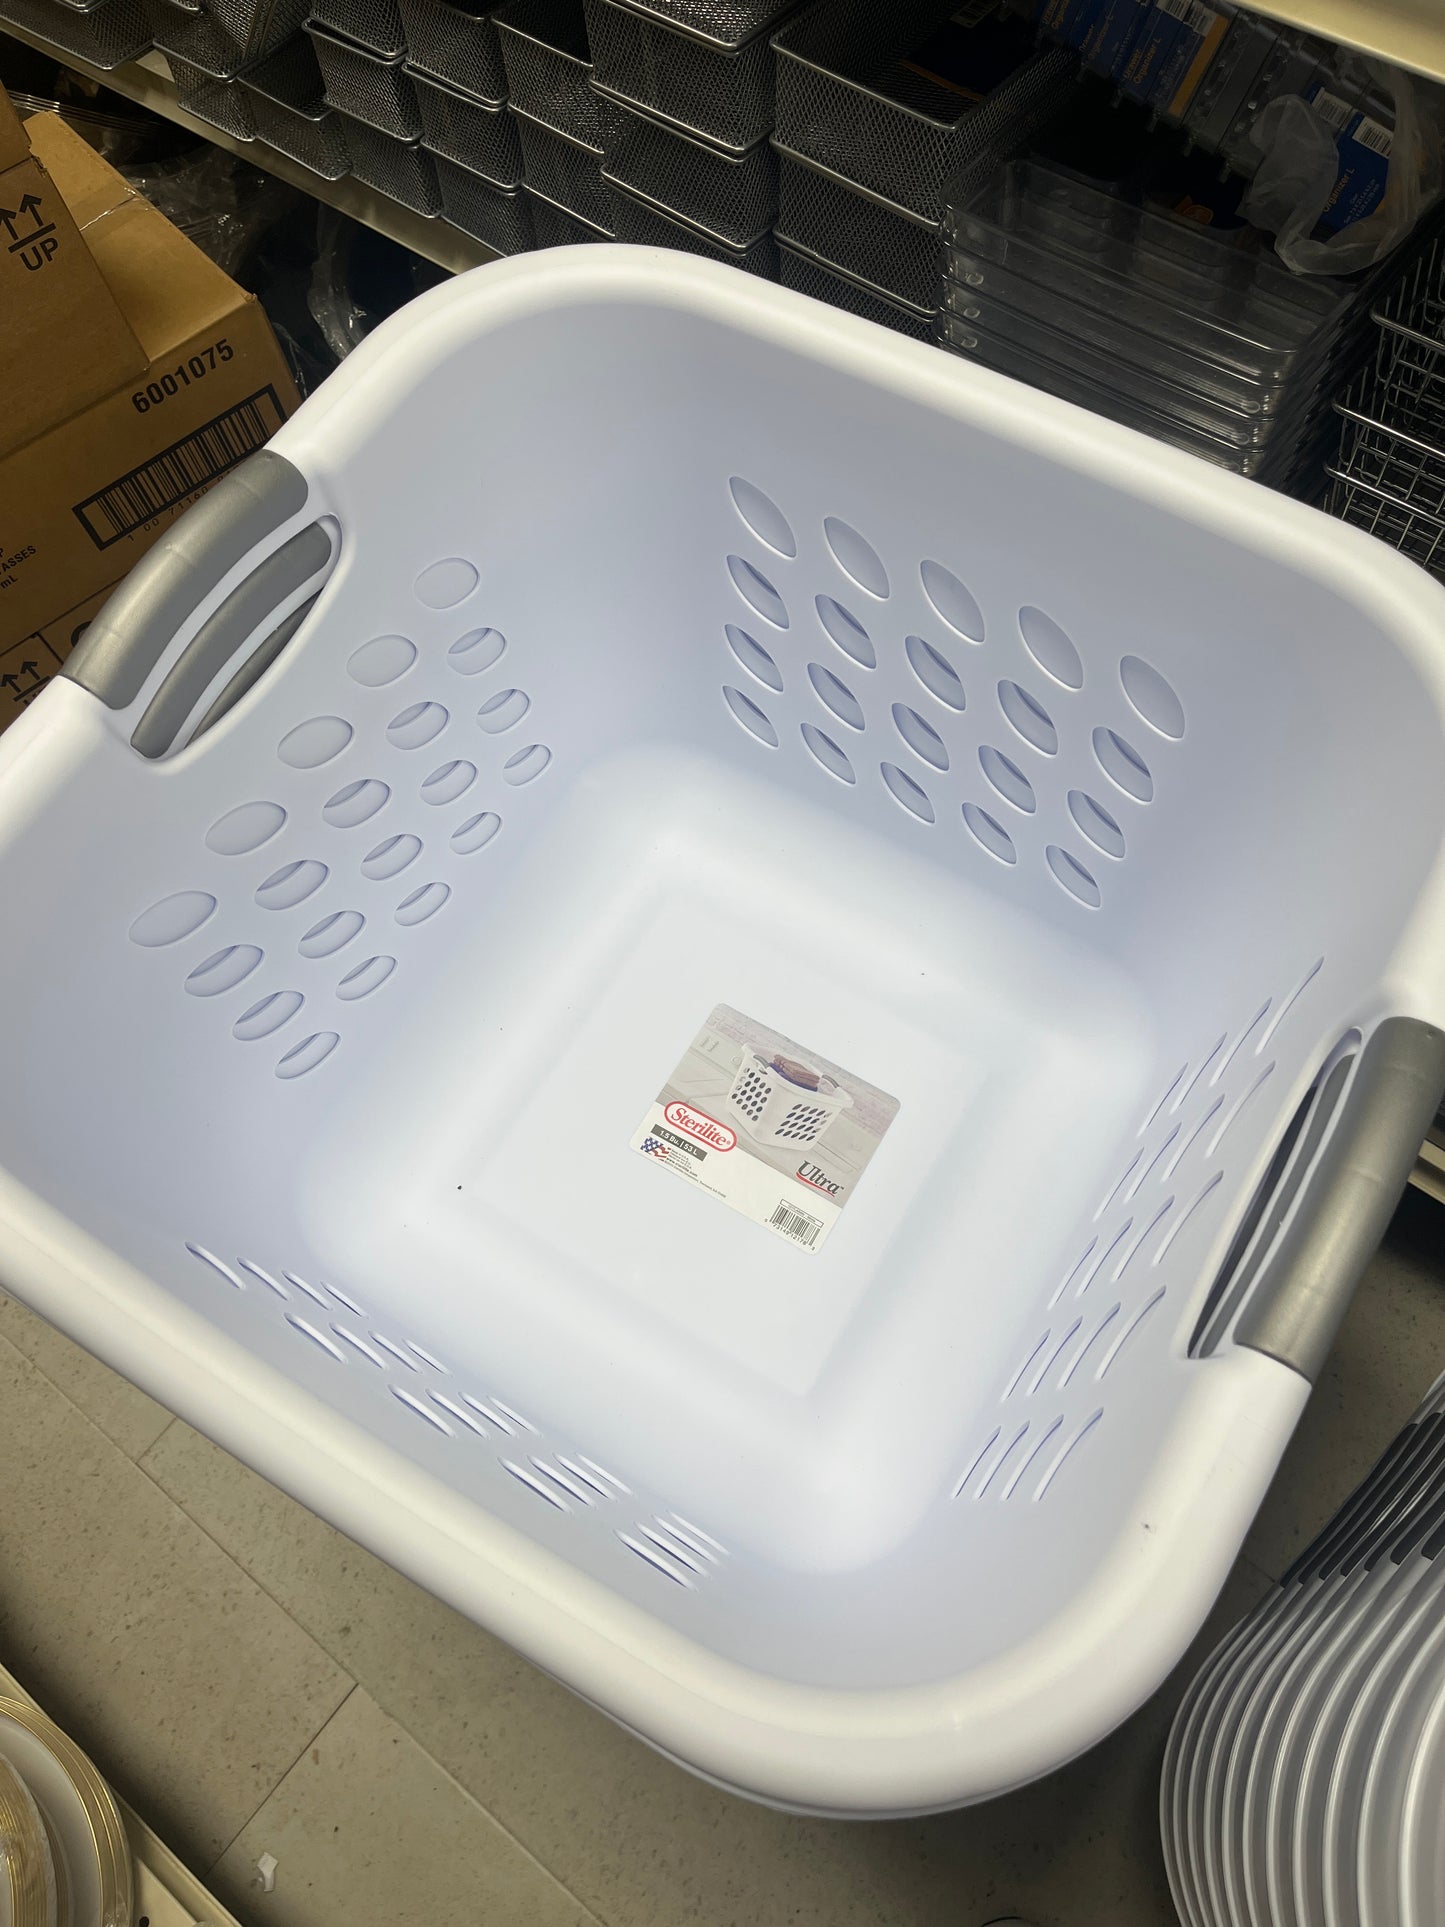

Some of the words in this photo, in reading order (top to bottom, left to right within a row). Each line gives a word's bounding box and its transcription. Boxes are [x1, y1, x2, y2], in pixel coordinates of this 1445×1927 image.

[1133, 46, 1157, 84] Organizer
[20, 237, 58, 271] UP
[132, 339, 233, 413] 6001075
[683, 1143, 694, 1152] 53
